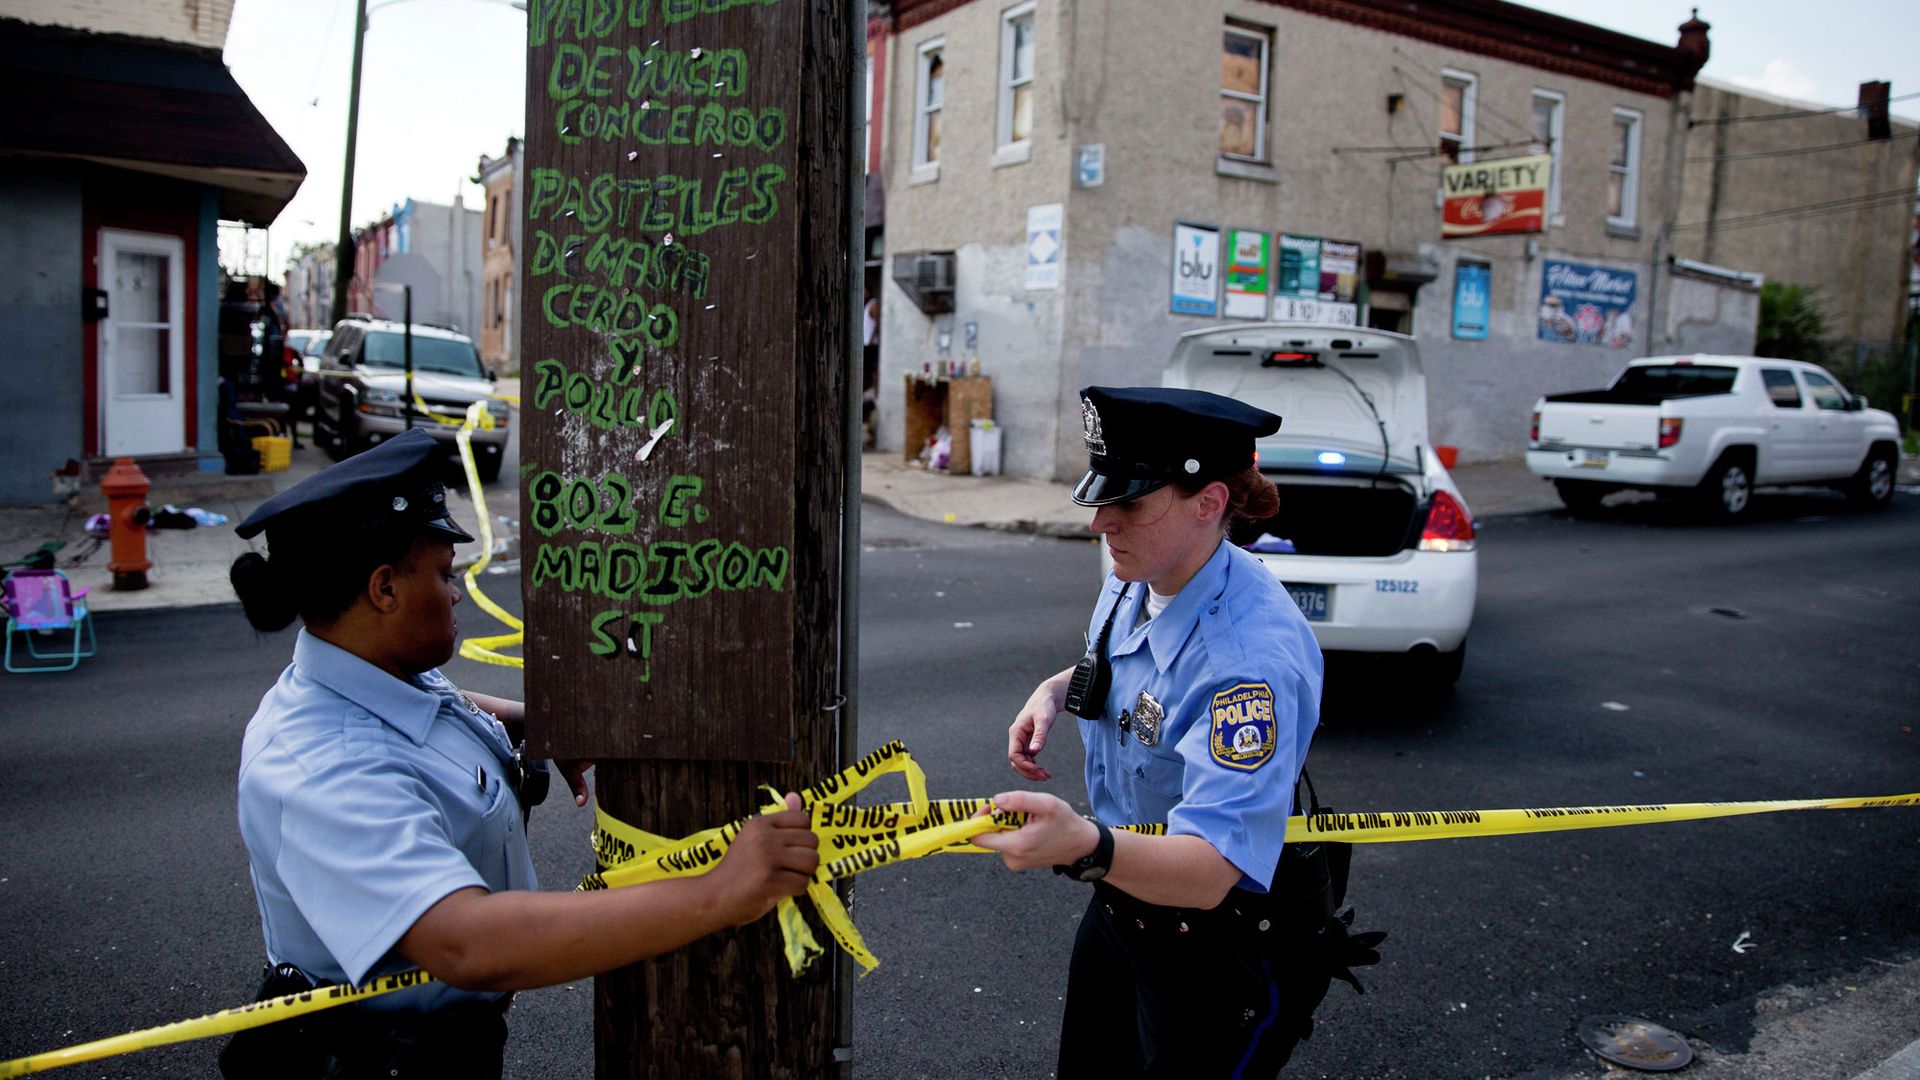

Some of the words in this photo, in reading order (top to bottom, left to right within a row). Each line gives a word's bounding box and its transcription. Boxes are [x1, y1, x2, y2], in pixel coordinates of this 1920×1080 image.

[1446, 164, 1539, 193] VARIETY
[529, 163, 787, 236] PASTELES
[1180, 249, 1213, 280] blu
[1461, 280, 1485, 307] blu
[608, 337, 645, 386] Y
[530, 472, 637, 536] 802
[531, 539, 789, 606] MADISON
[1375, 579, 1419, 593] 125122
[588, 610, 664, 682] ST
[1215, 690, 1270, 708] PHILADELPHIA
[1215, 699, 1271, 729] POLICE
